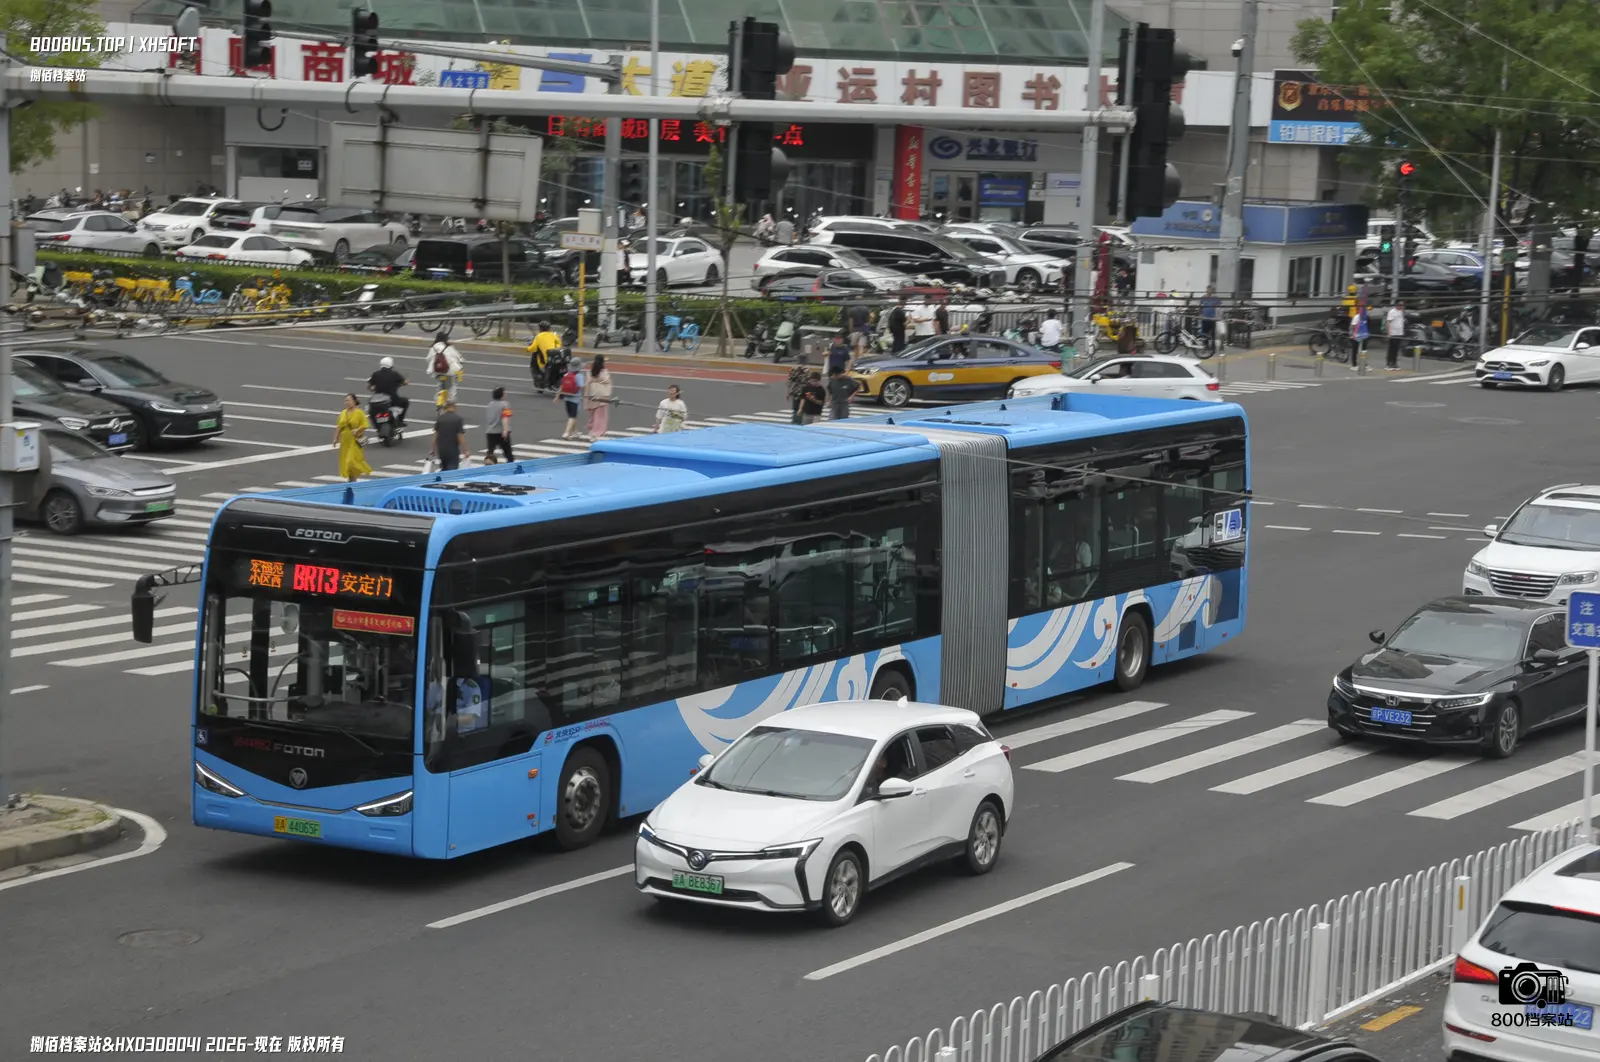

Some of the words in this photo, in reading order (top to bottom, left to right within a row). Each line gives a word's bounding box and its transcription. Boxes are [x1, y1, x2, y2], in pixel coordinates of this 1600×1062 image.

[295, 528, 342, 541] FOTON
[292, 563, 340, 595] BRT3
[340, 572, 393, 598] 安定门
[273, 742, 325, 758] FOTON
